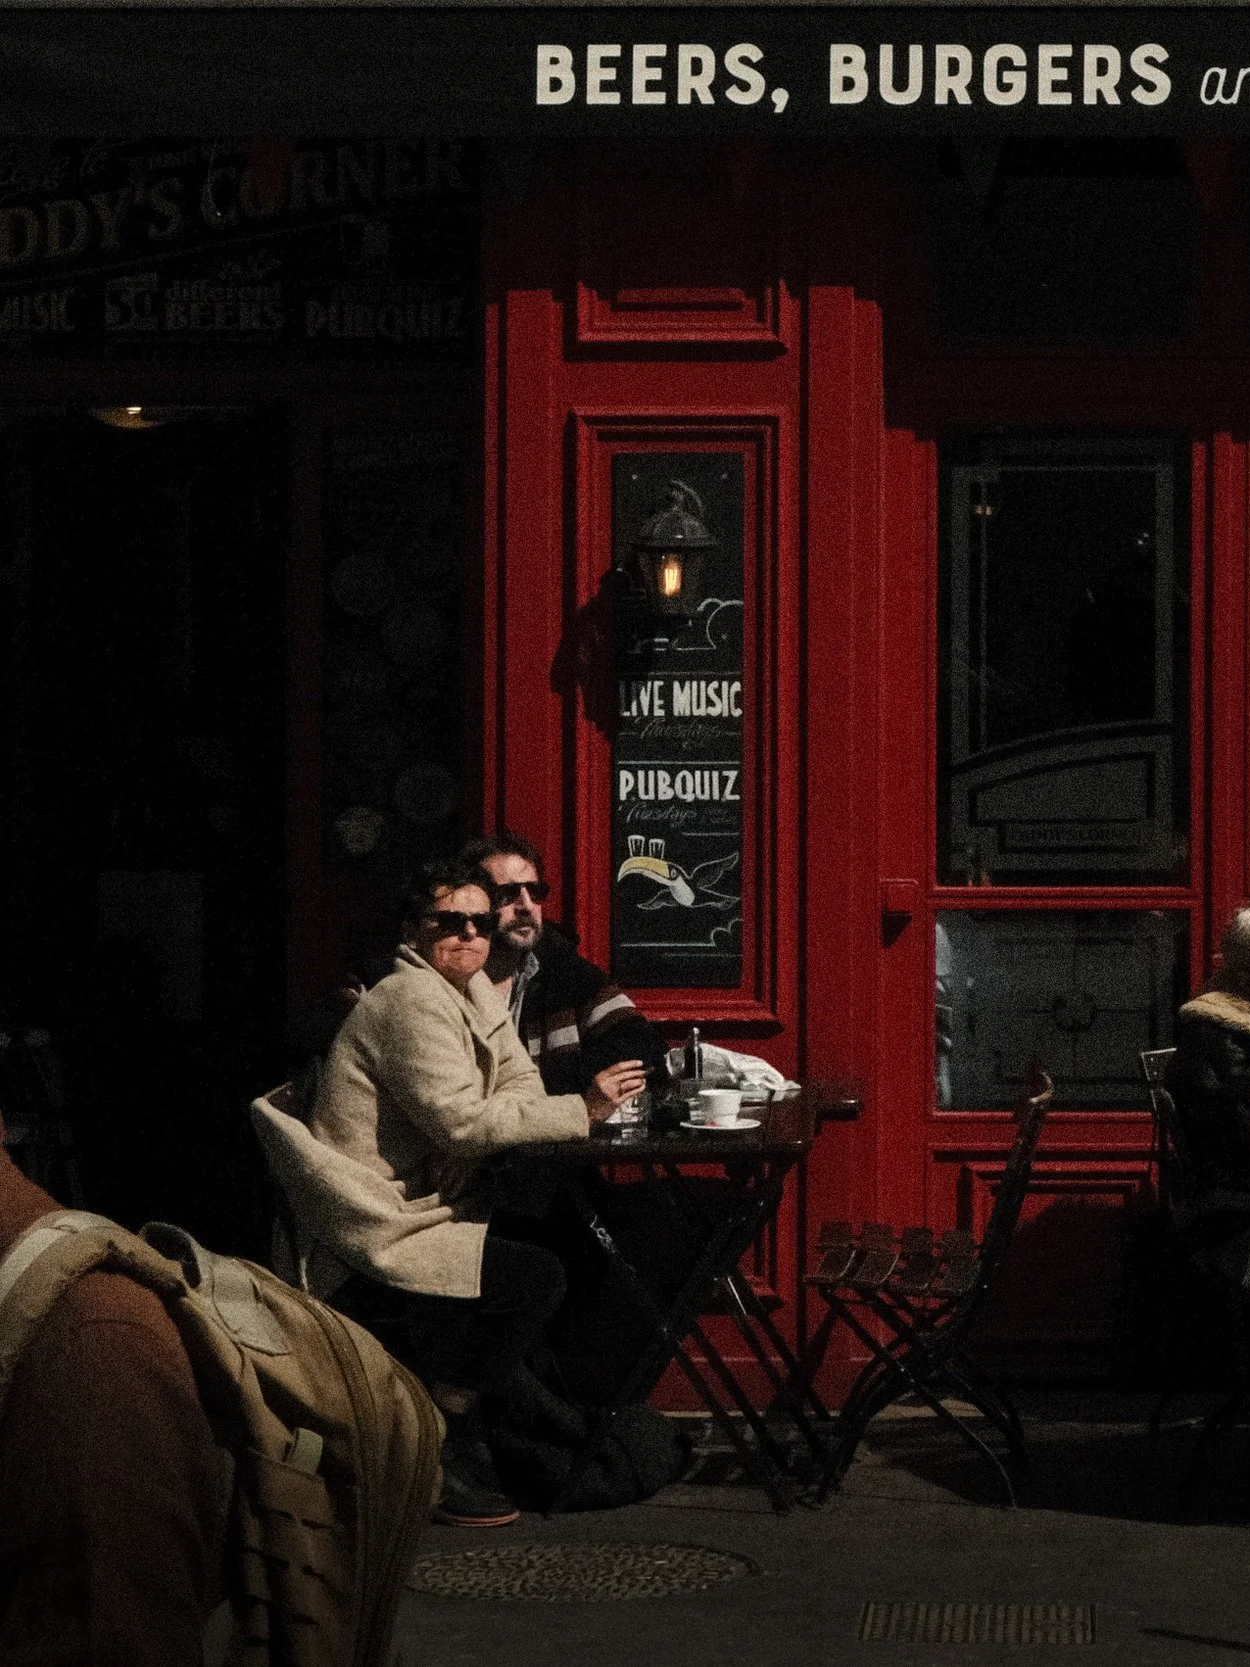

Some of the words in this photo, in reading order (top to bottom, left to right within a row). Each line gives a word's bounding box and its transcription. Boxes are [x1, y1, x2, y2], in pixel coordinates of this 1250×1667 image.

[536, 43, 789, 113] BEERS,
[830, 44, 1171, 105] BURGERS
[619, 680, 665, 717] LIVE
[673, 680, 743, 718] MUSIC
[618, 769, 741, 802] PUBQUIZ
